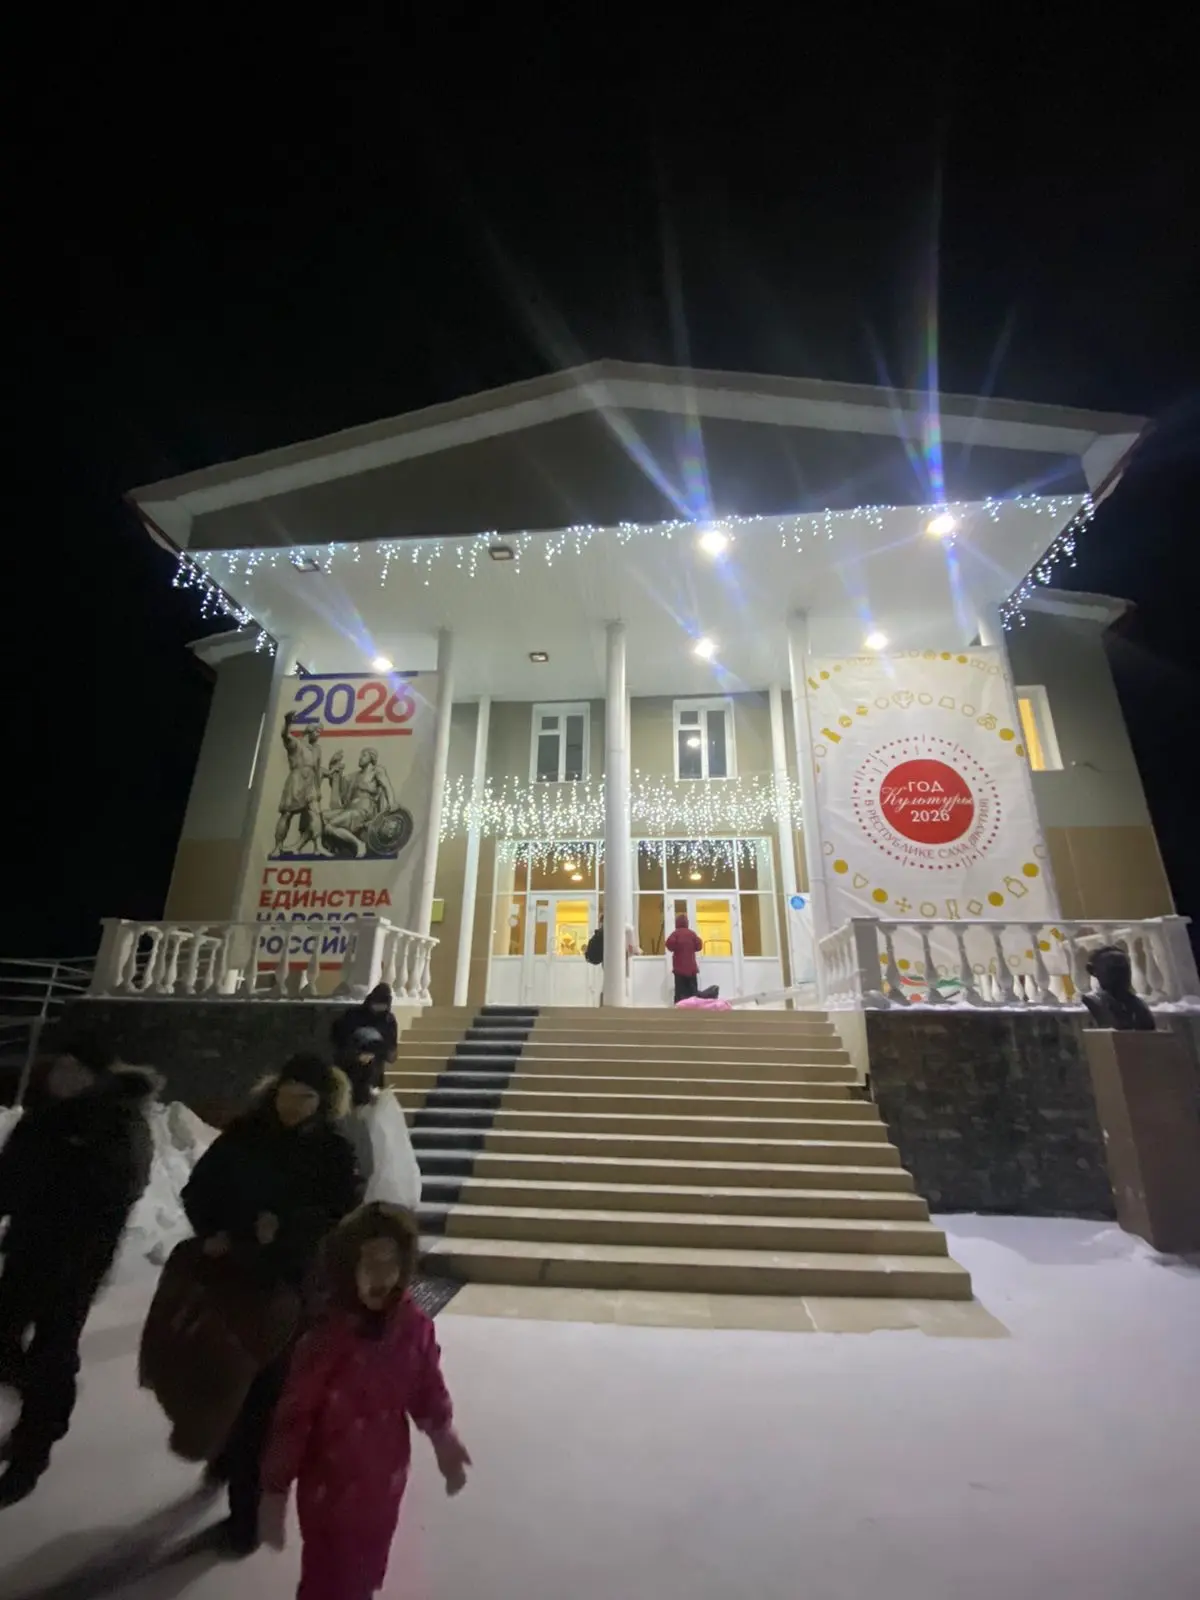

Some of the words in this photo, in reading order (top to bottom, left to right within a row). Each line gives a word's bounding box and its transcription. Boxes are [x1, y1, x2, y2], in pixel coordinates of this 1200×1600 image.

[293, 682, 416, 724] 2026
[908, 780, 944, 793] ГОД
[881, 786, 973, 812] Культуры
[911, 809, 950, 822] 2026
[867, 808, 935, 860] РЕСПУБЛИКЕ
[938, 843, 969, 860] САХА
[262, 867, 312, 887] ГОД
[259, 888, 392, 910] ЕДИНСТВА
